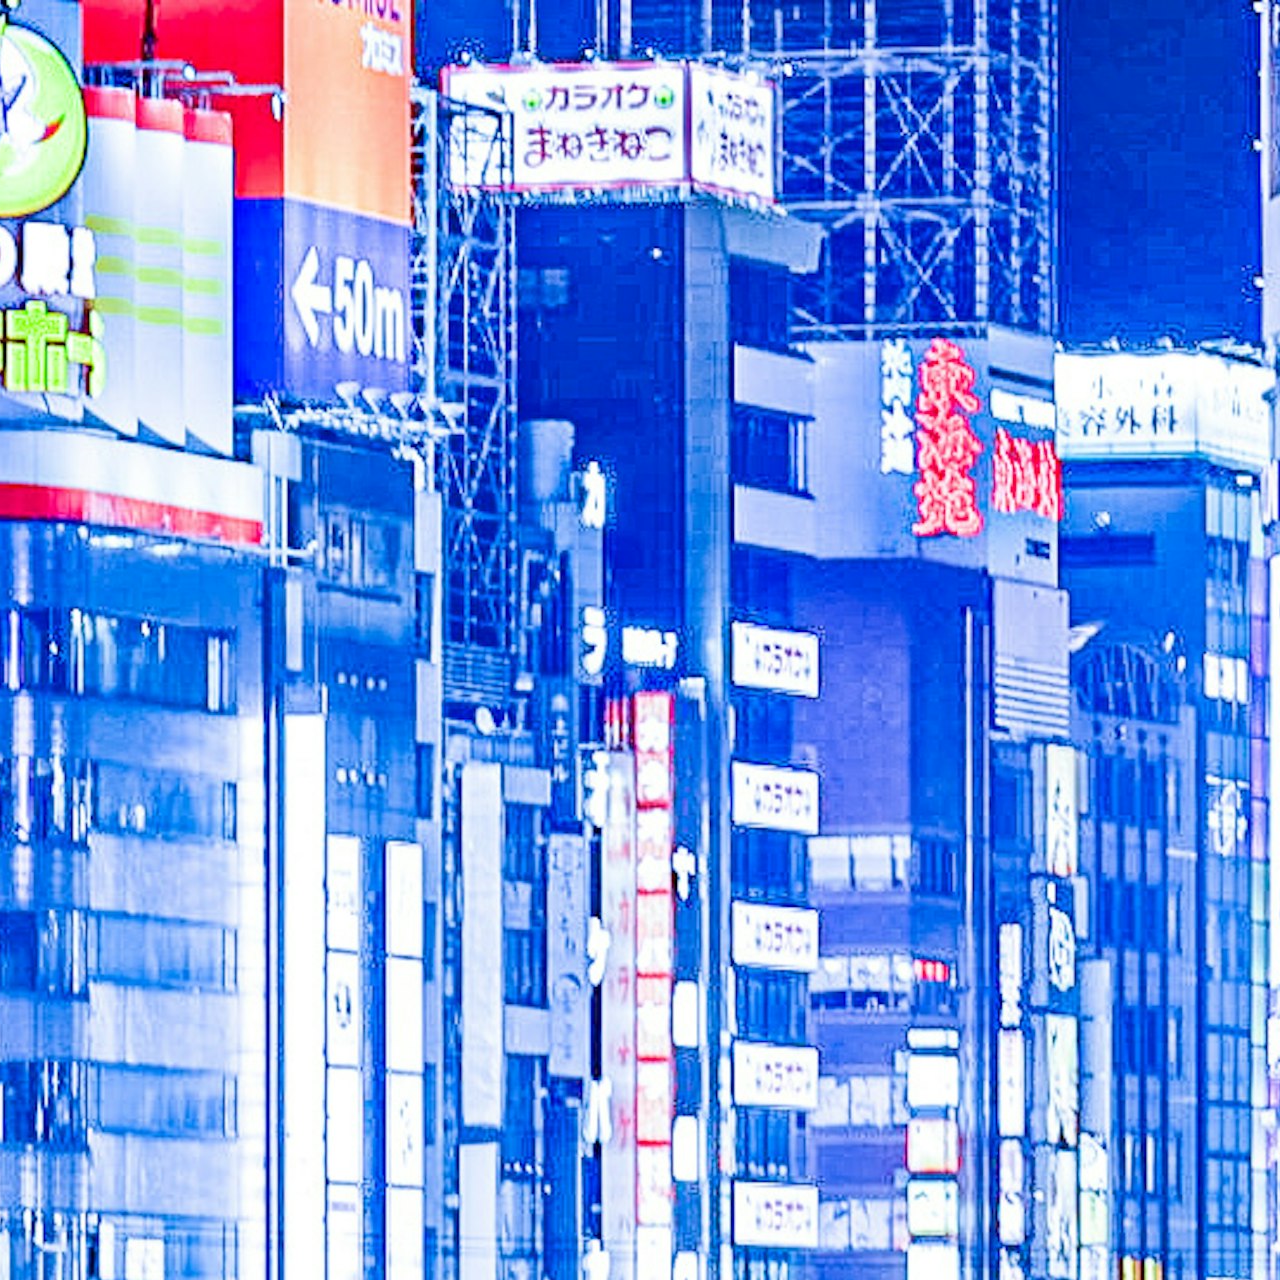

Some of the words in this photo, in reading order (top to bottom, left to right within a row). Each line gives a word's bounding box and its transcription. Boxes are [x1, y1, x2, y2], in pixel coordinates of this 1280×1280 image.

[545, 84, 651, 111] カラオケ
[523, 123, 673, 168] まねきねこ
[333, 256, 407, 362] 50m
